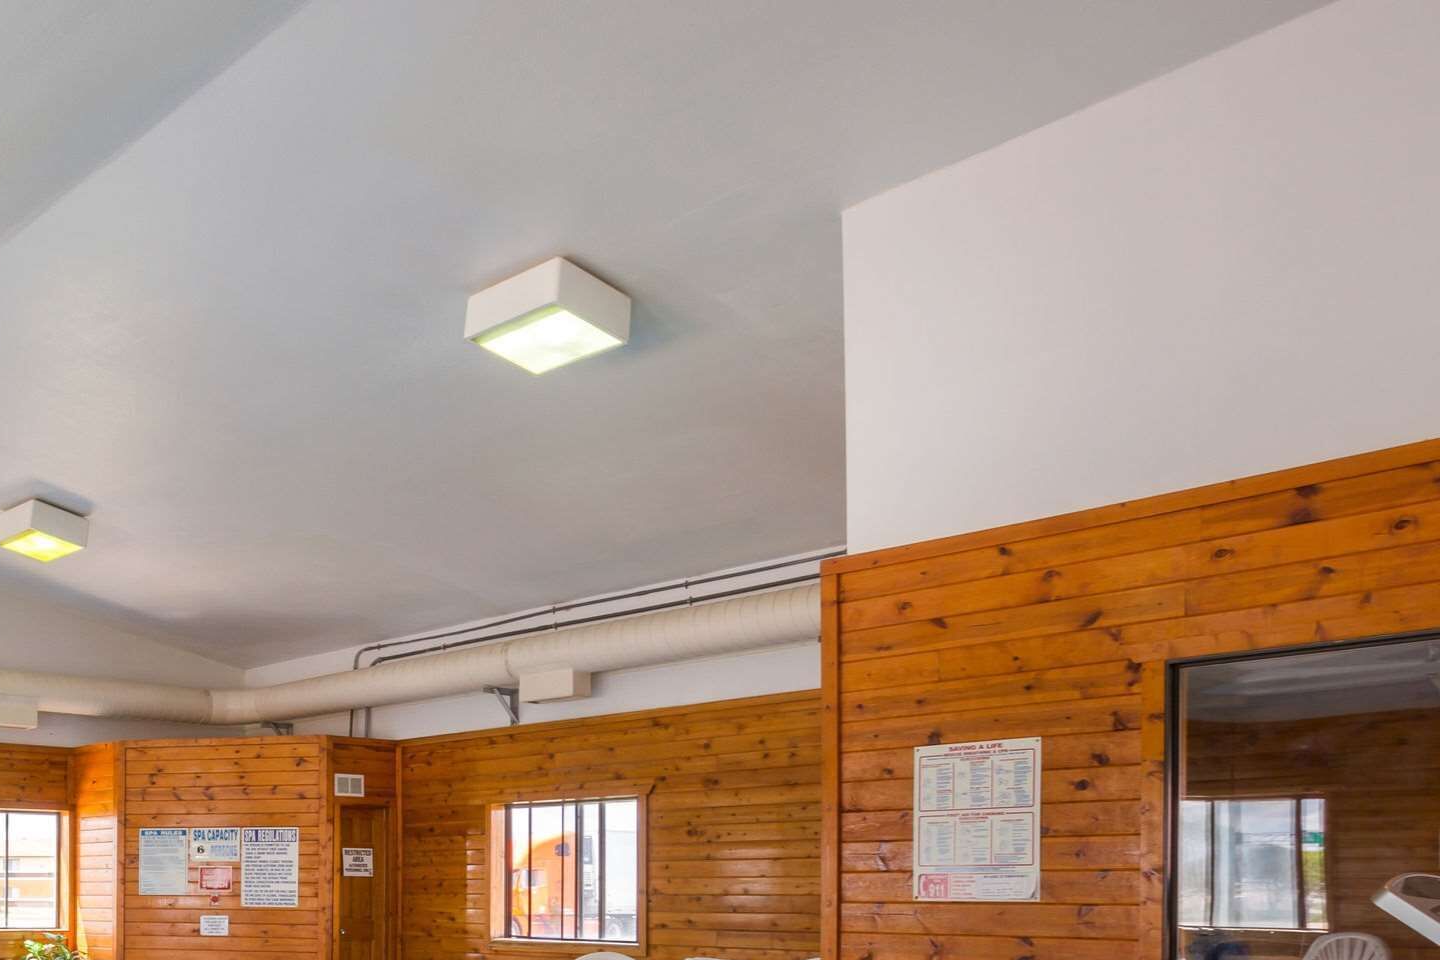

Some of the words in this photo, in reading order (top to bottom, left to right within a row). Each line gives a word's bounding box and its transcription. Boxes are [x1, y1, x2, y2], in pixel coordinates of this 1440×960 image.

[948, 744, 977, 752] SAVING
[193, 829, 206, 841] SPA
[207, 829, 239, 841] CAPACITY
[244, 830, 256, 842] SPA
[257, 830, 296, 842] REGULATIONS
[197, 844, 205, 854] 6
[928, 883, 945, 897] 911
